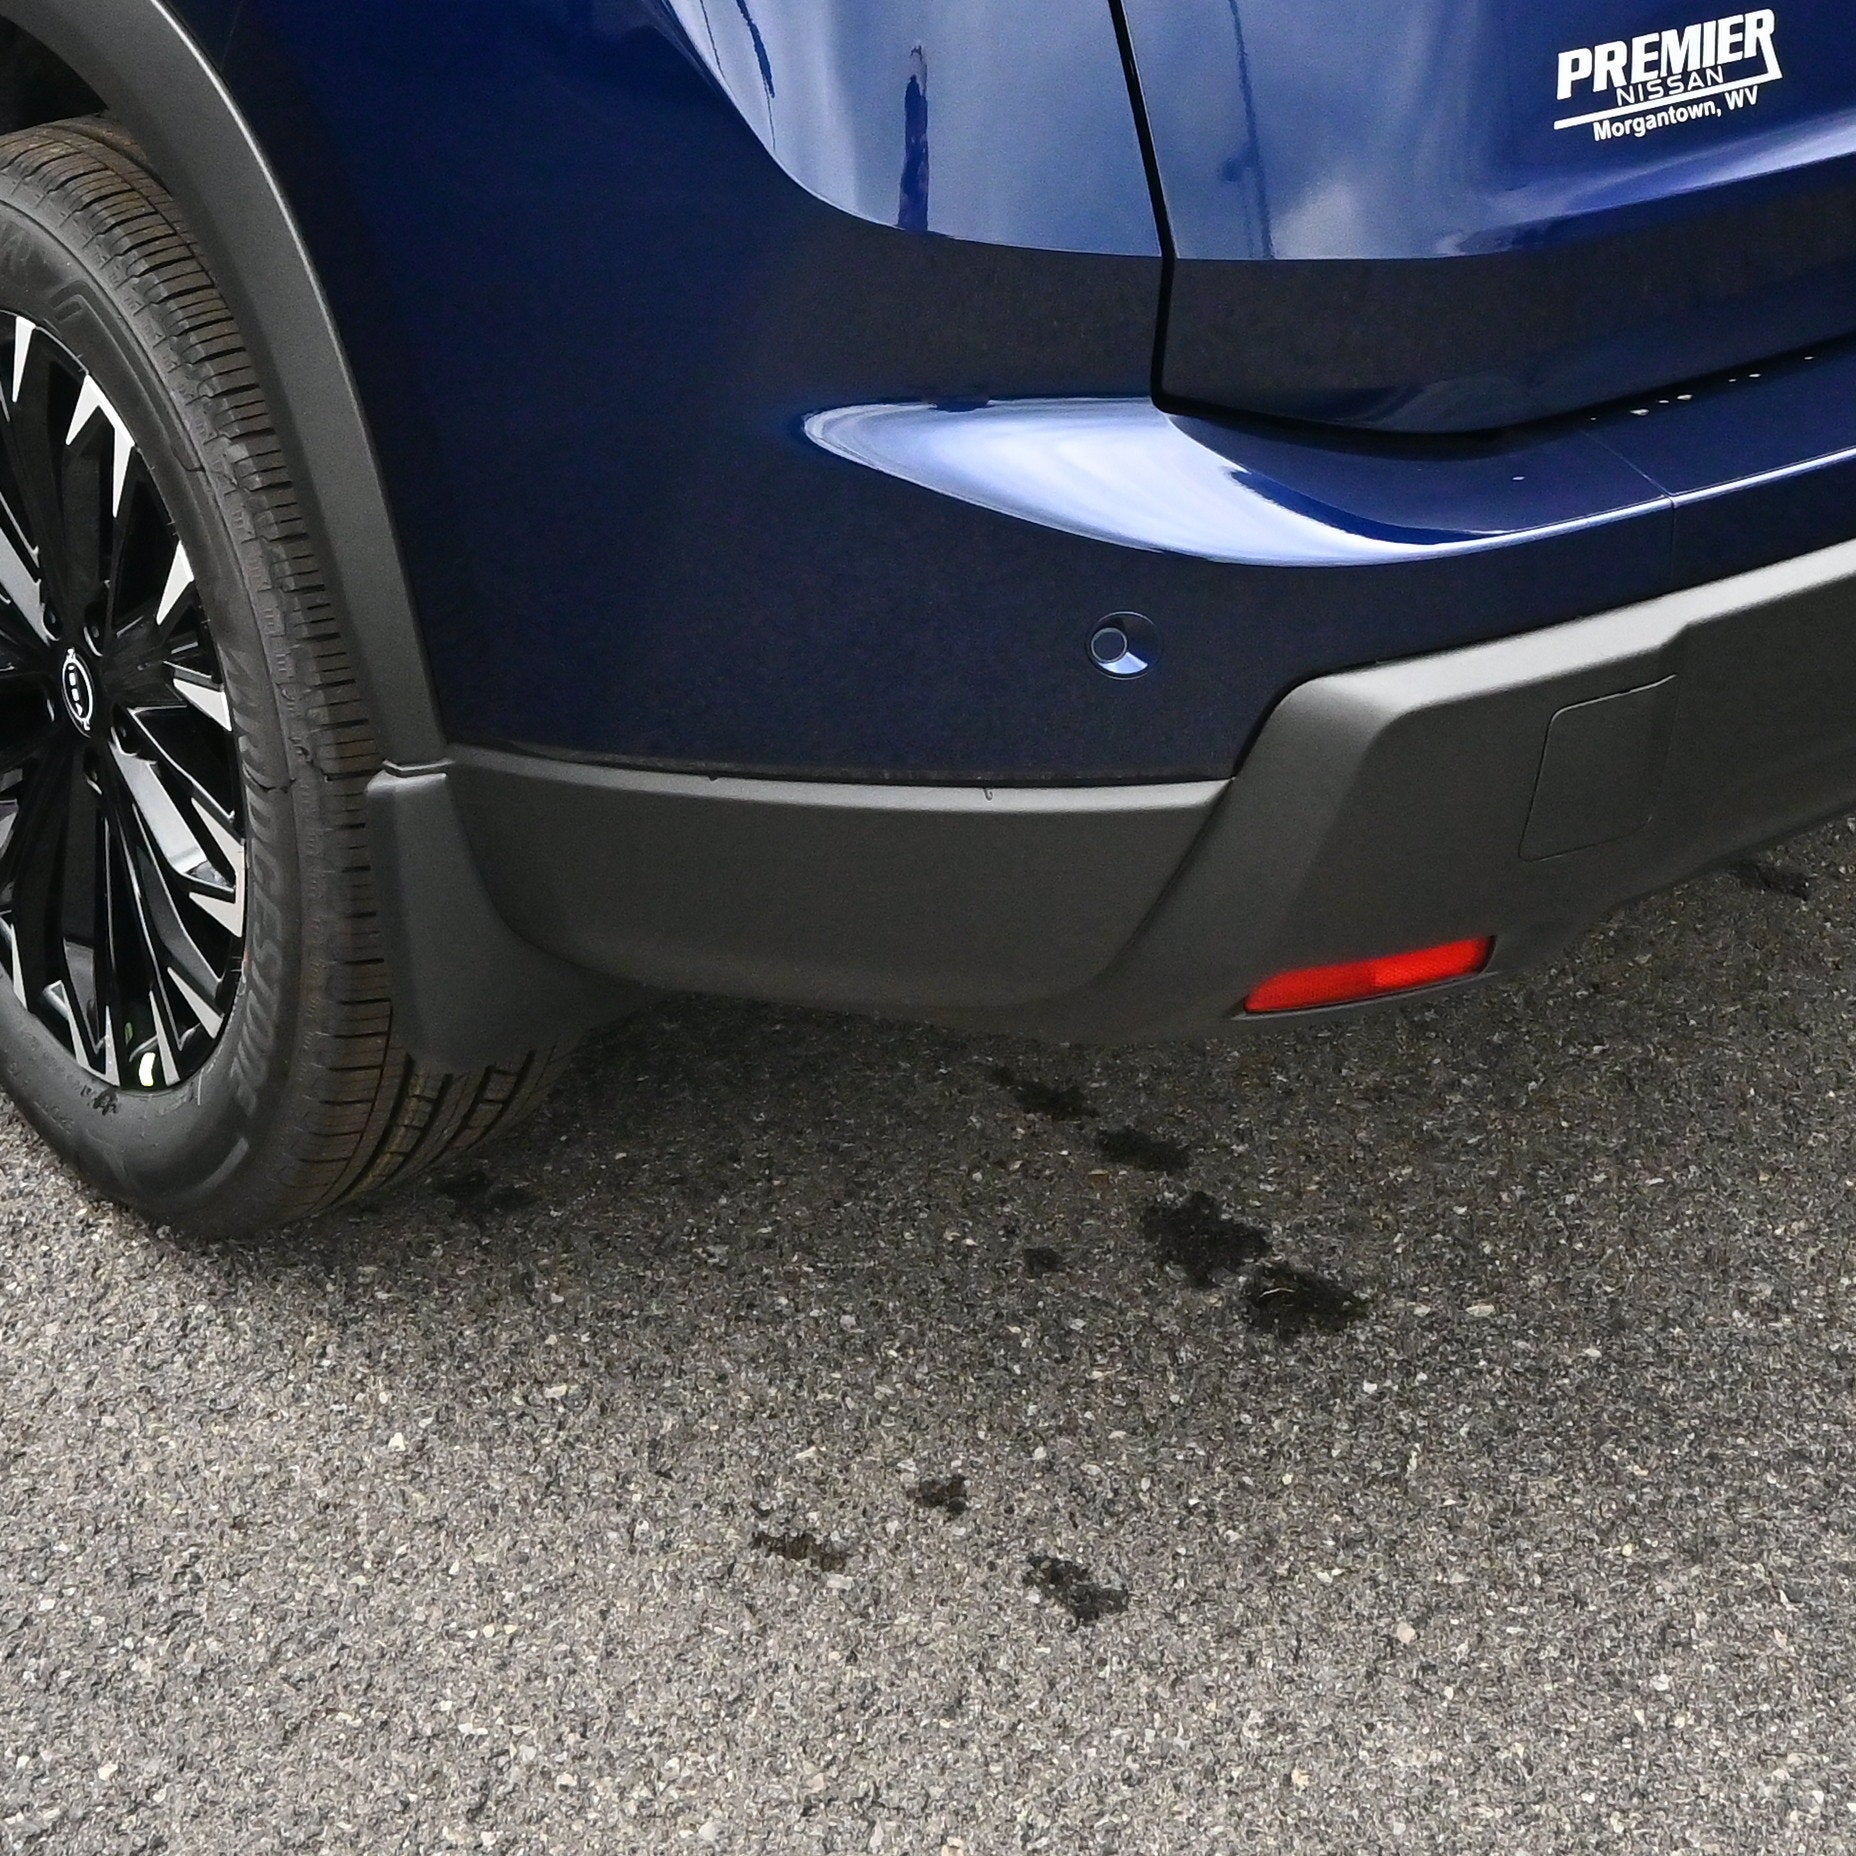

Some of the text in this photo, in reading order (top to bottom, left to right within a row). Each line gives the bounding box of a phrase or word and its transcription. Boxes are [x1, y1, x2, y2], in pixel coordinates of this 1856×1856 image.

[1556, 8, 1783, 100] PREMIER
[1593, 85, 1759, 142] Morgantown, WV
[1616, 65, 1724, 107] NISSAN
